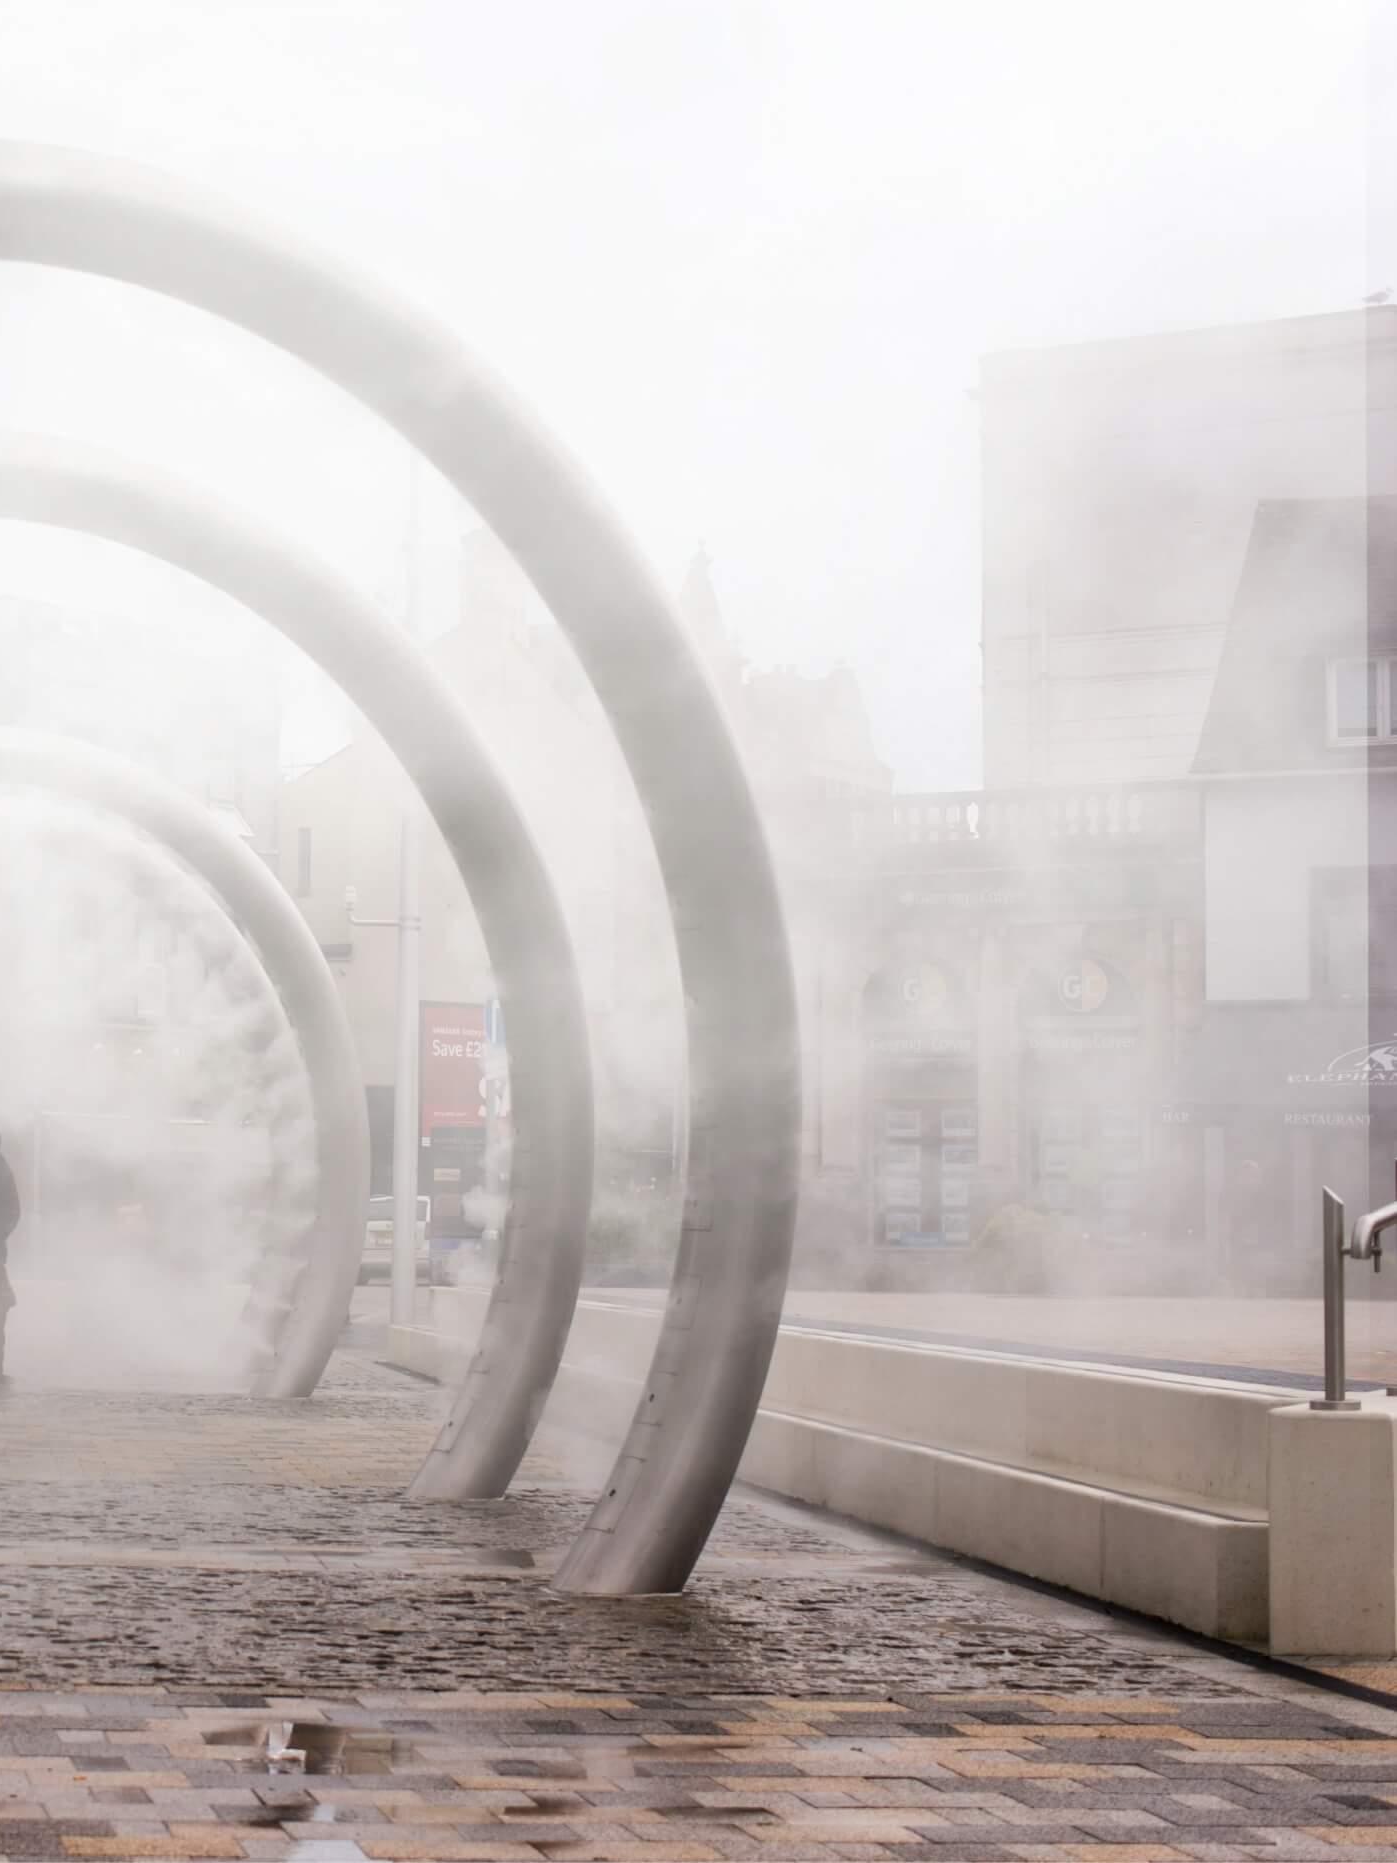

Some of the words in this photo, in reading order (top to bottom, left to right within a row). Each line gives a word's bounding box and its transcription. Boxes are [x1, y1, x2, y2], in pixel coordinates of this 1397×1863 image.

[432, 1039, 463, 1057] Save
[1161, 1111, 1190, 1123] BAR
[1283, 1111, 1372, 1126] RESTAURANT
